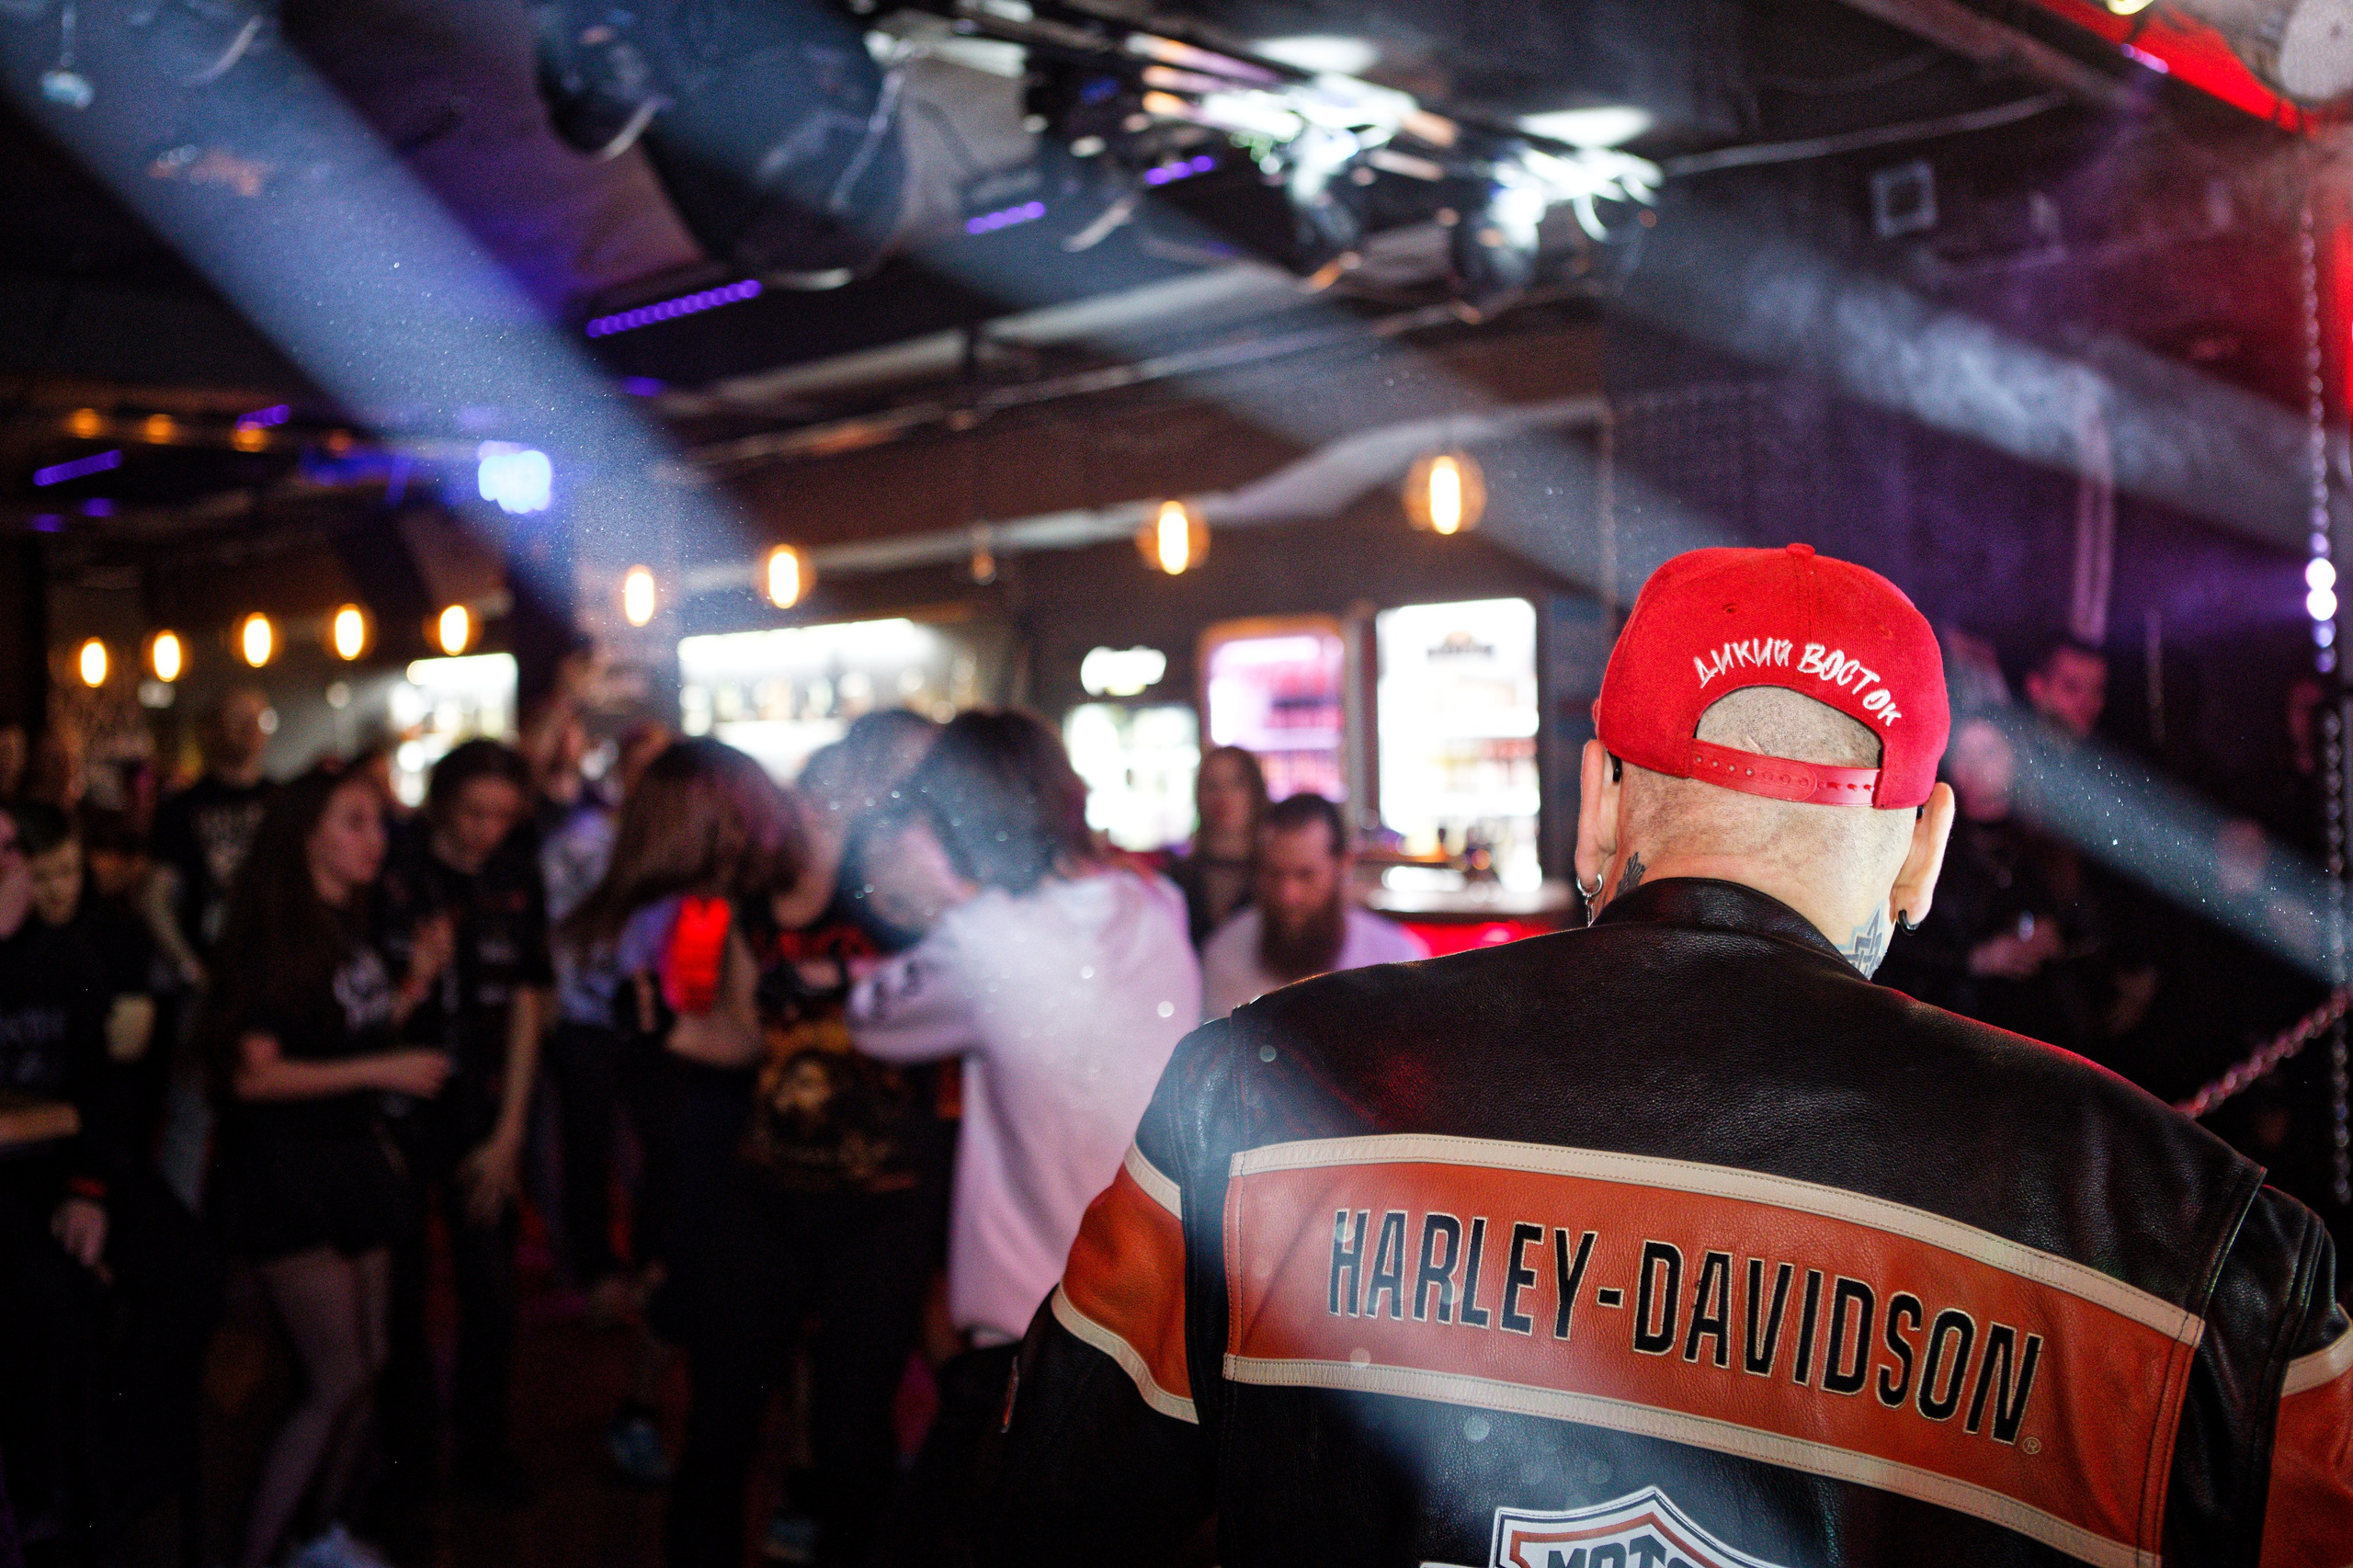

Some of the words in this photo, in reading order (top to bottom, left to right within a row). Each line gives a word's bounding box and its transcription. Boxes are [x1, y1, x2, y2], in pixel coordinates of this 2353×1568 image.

[1693, 637, 1793, 689] ДИКИЙ
[1796, 642, 1903, 727] ВОСТОК
[1328, 1208, 2045, 1446] HARLEY-DAVIDSON
